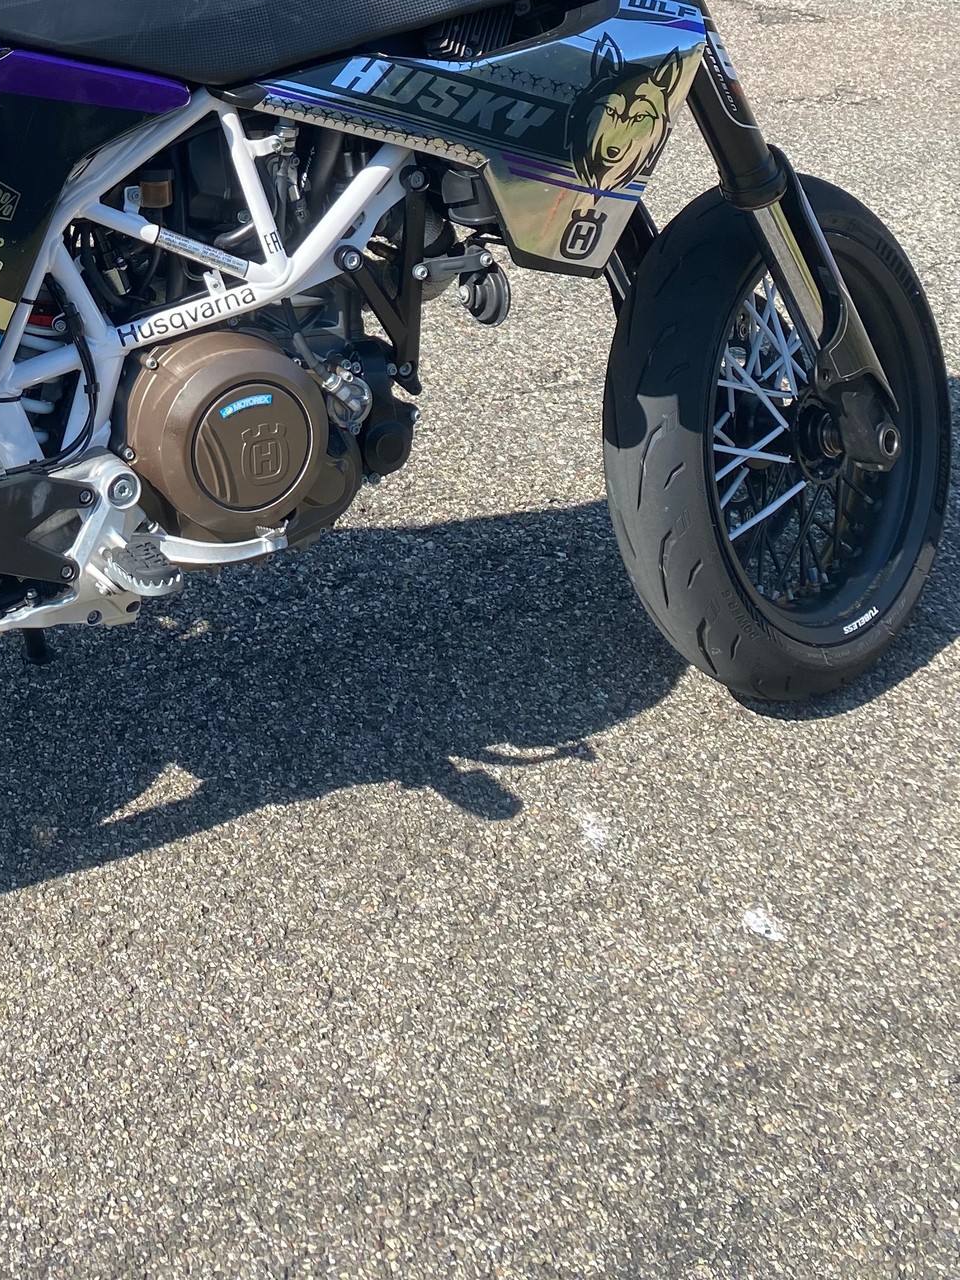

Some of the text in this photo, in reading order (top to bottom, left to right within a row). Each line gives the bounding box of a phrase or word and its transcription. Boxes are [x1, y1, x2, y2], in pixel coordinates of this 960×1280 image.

[331, 58, 555, 138] HUSKY
[116, 285, 256, 348] Husqvarna
[233, 396, 269, 410] MOTOREX
[843, 605, 879, 636] TUBELESS
